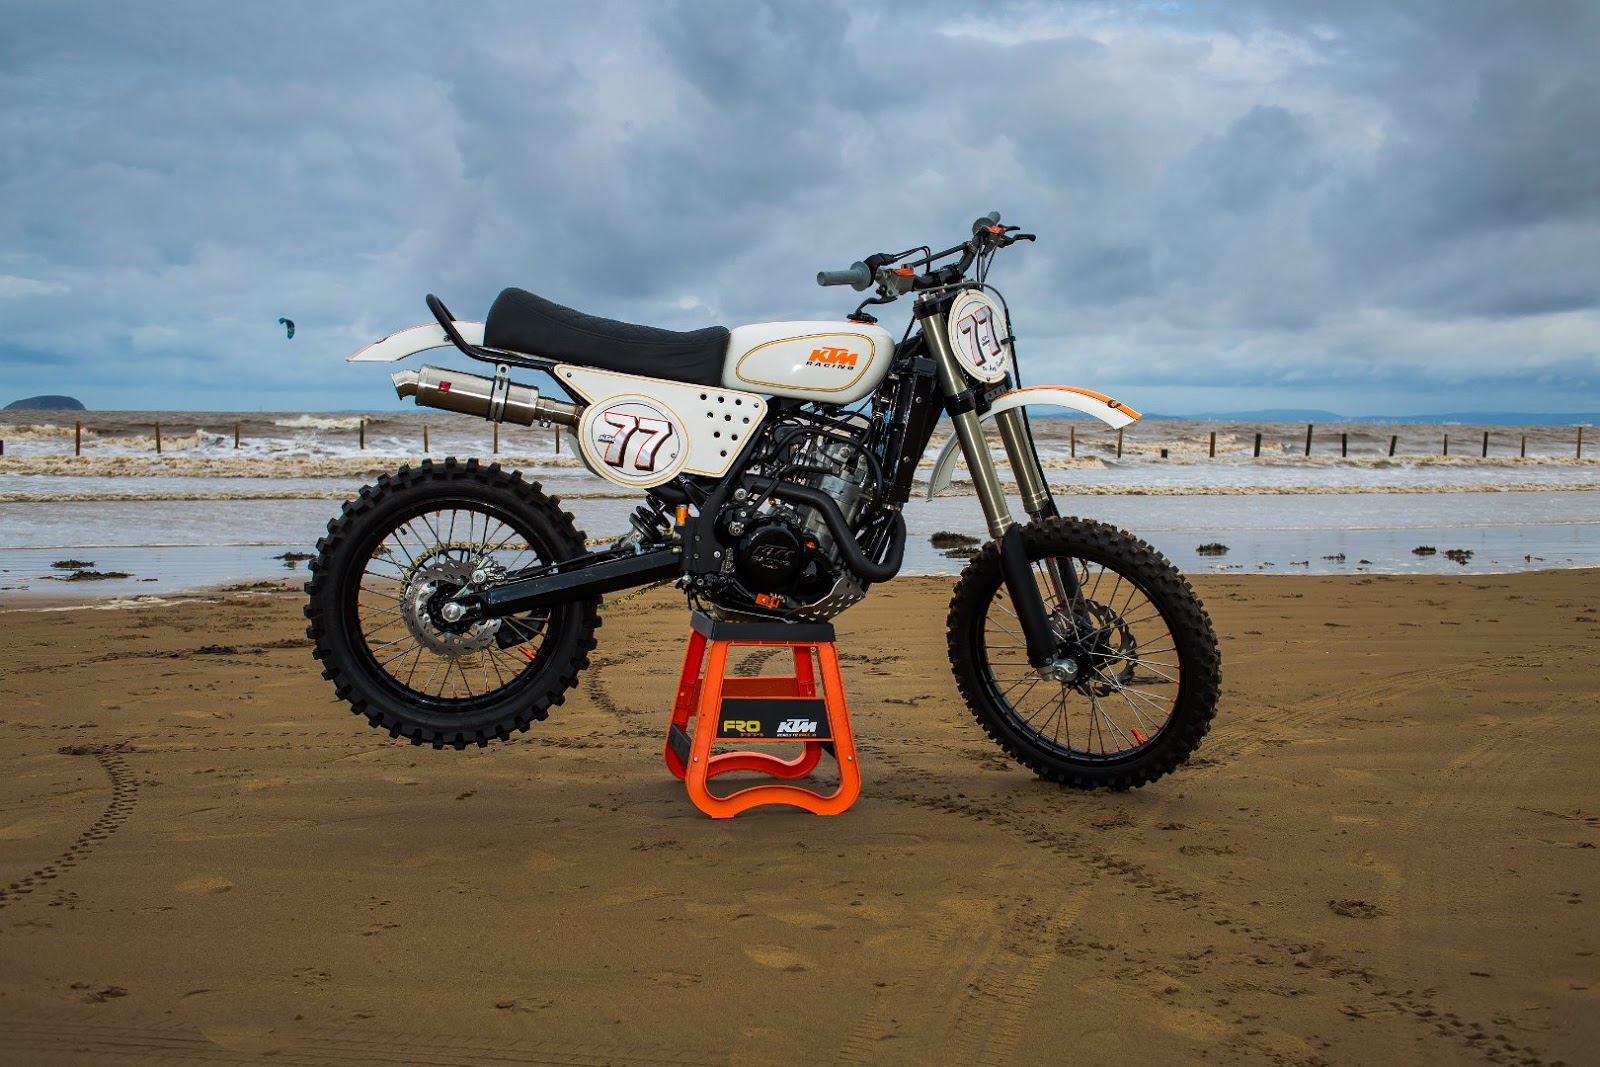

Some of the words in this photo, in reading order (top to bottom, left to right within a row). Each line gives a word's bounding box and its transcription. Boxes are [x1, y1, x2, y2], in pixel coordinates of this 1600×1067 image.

[958, 305, 1001, 366] 77
[808, 346, 859, 366] KTM
[806, 361, 854, 370] RACING
[604, 411, 673, 471] 77
[723, 720, 761, 732] FRO
[776, 718, 817, 733] KTM
